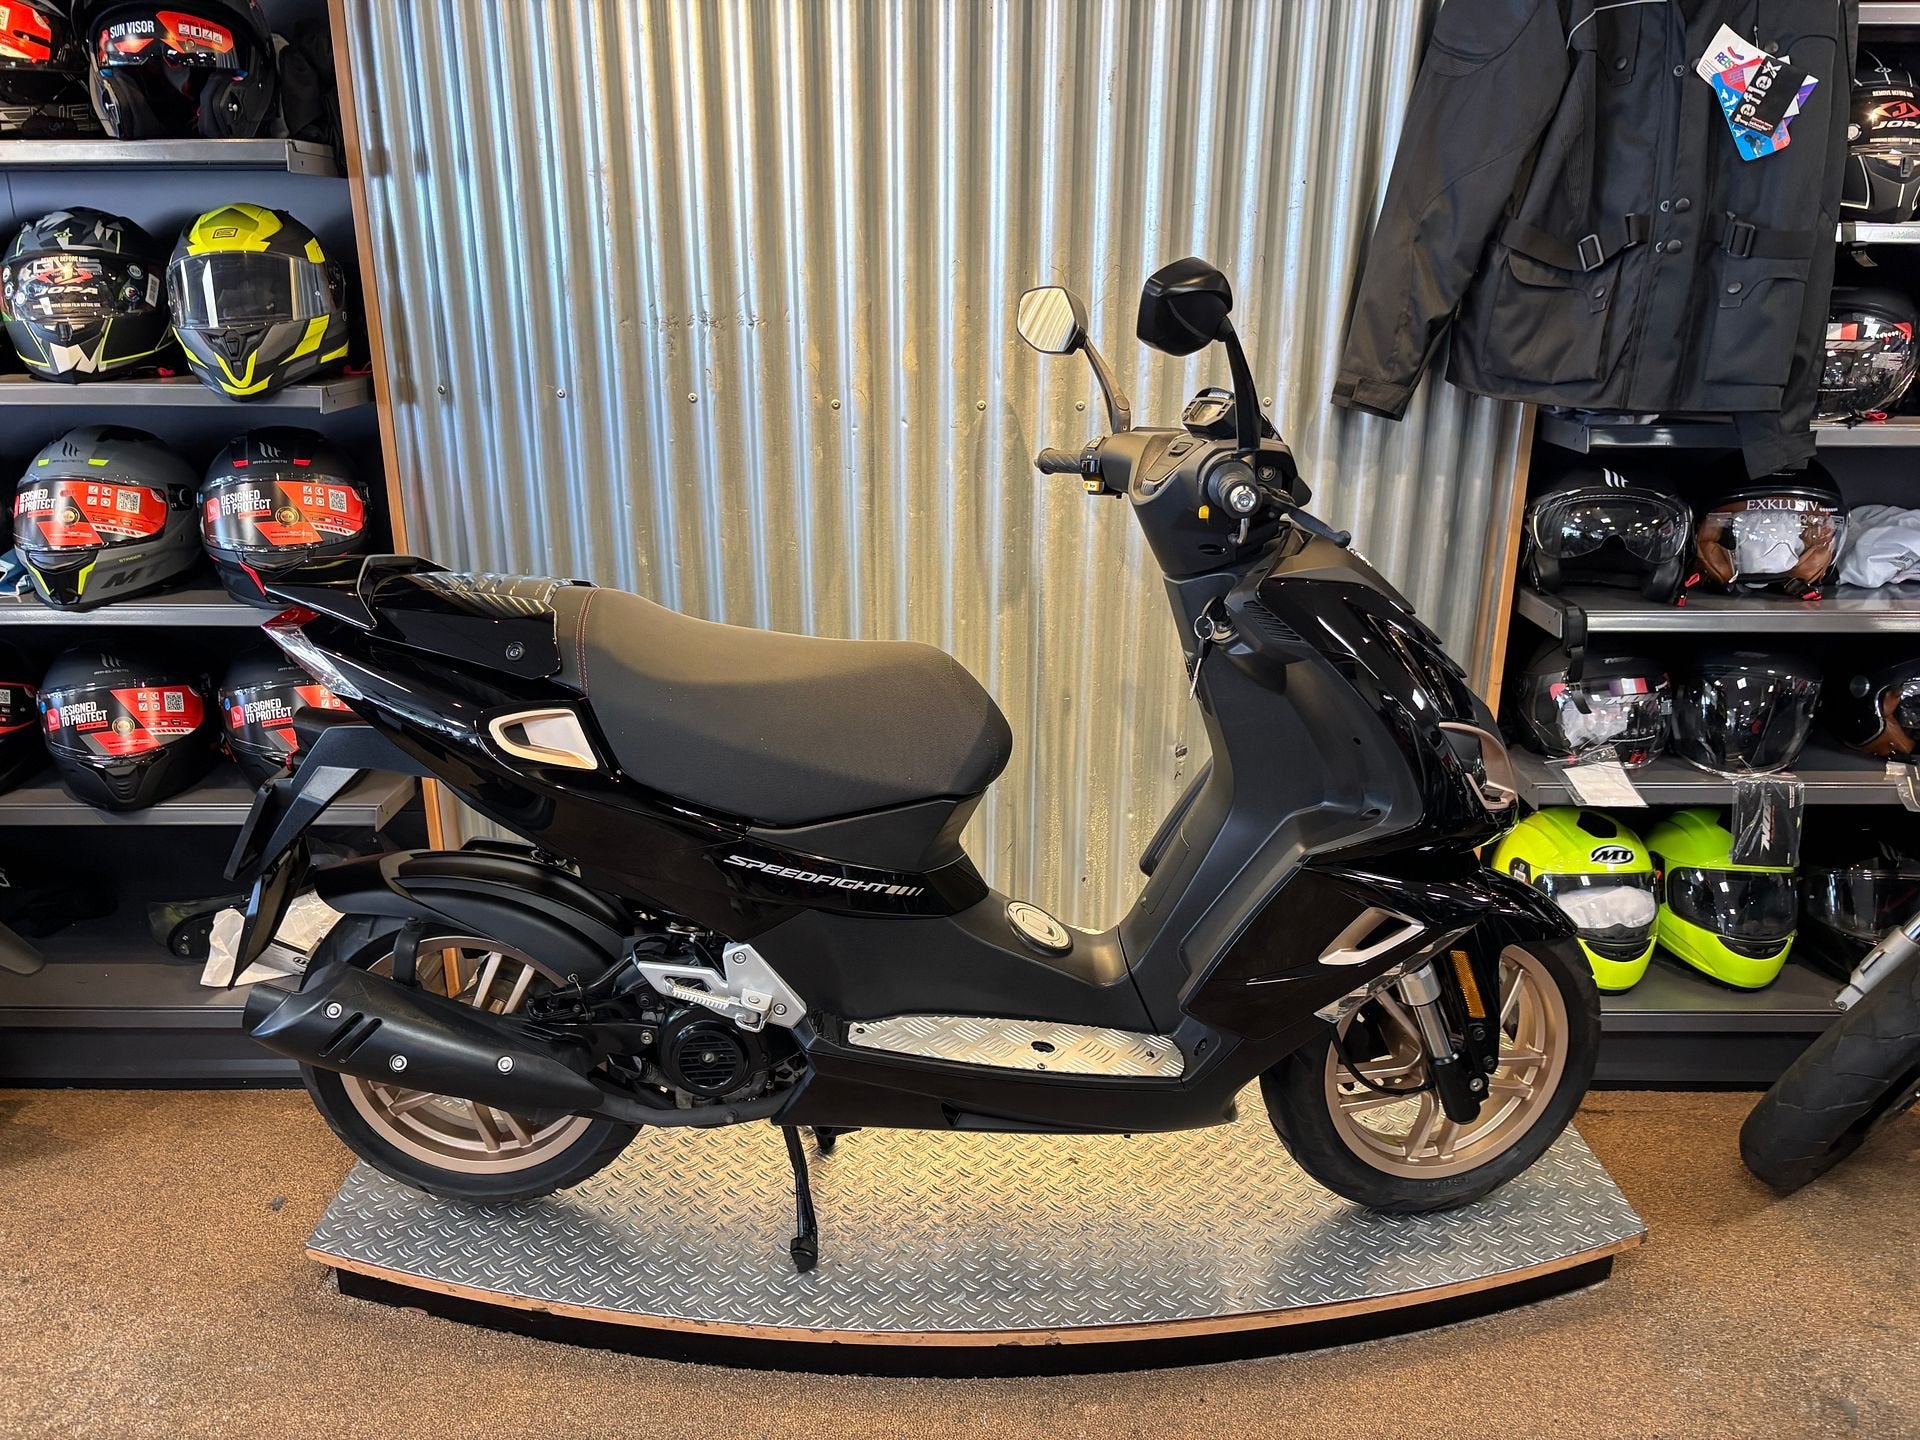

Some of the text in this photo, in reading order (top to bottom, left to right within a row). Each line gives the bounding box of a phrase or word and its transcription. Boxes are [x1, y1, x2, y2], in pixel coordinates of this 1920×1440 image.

[109, 20, 155, 39] SUN VISOR
[35, 286, 98, 297] JOPA
[19, 488, 48, 503] DESIGNED
[221, 489, 261, 506] DESIGNED
[25, 498, 56, 513] PROTECT
[221, 505, 231, 516] TO
[232, 498, 272, 514] PROTECT
[60, 701, 97, 716] DESIGNED
[245, 698, 282, 714] DESIGNED
[61, 709, 108, 727] TO PROTECT
[246, 706, 292, 725] TO PROTECT
[723, 854, 891, 894] SPEEDFIGHT
